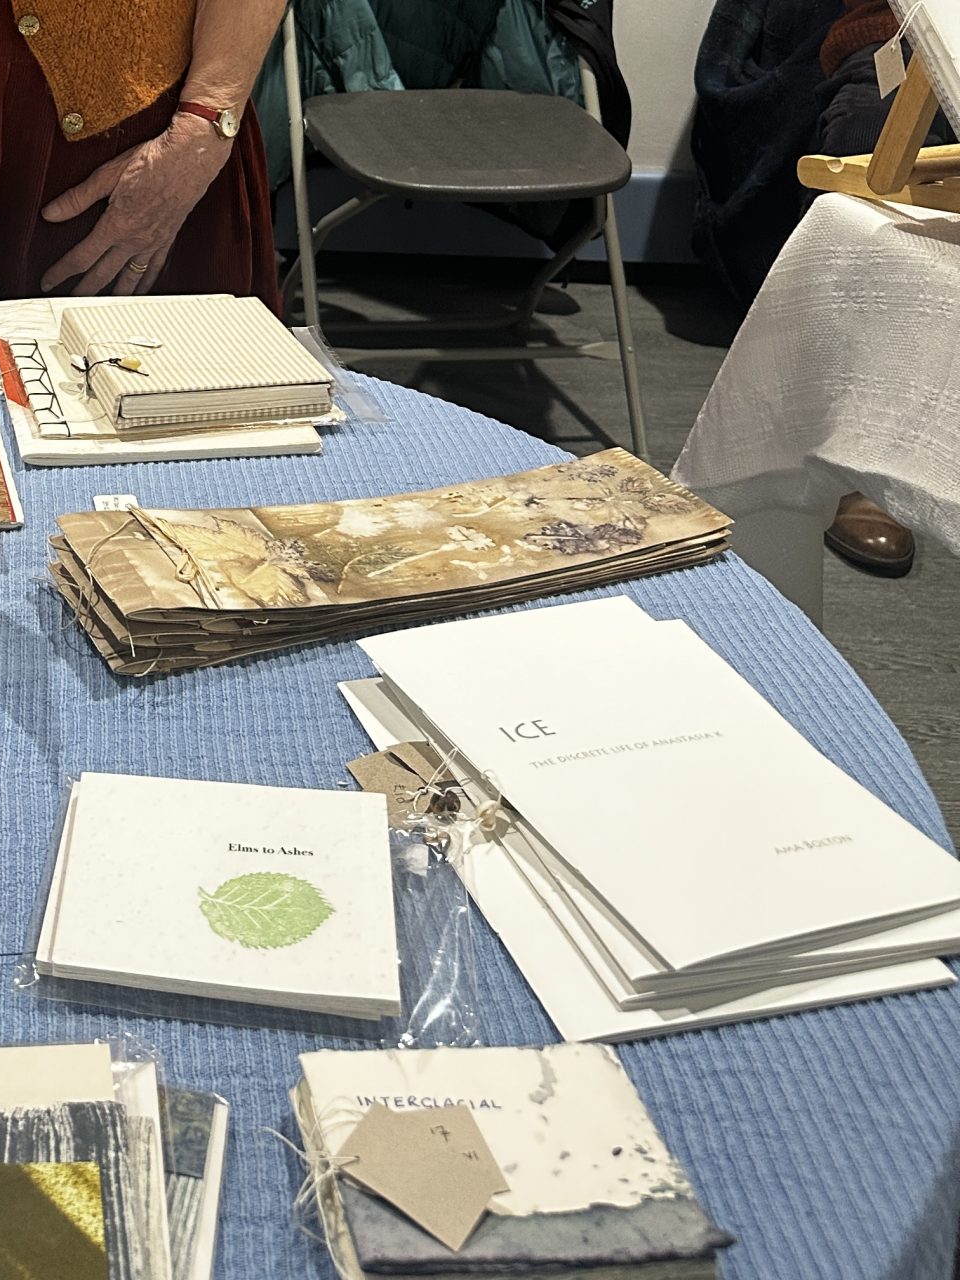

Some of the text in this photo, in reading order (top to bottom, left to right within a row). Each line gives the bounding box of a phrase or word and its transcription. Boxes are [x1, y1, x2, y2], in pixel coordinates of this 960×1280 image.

[498, 719, 557, 743] ICE
[529, 758, 554, 770] THE
[556, 747, 609, 764] DISCRETE
[609, 744, 634, 754] LIFE
[634, 740, 649, 750] OF
[652, 732, 712, 747] ANASTASIA
[228, 843, 259, 854] Elms
[278, 846, 314, 856] Ashes
